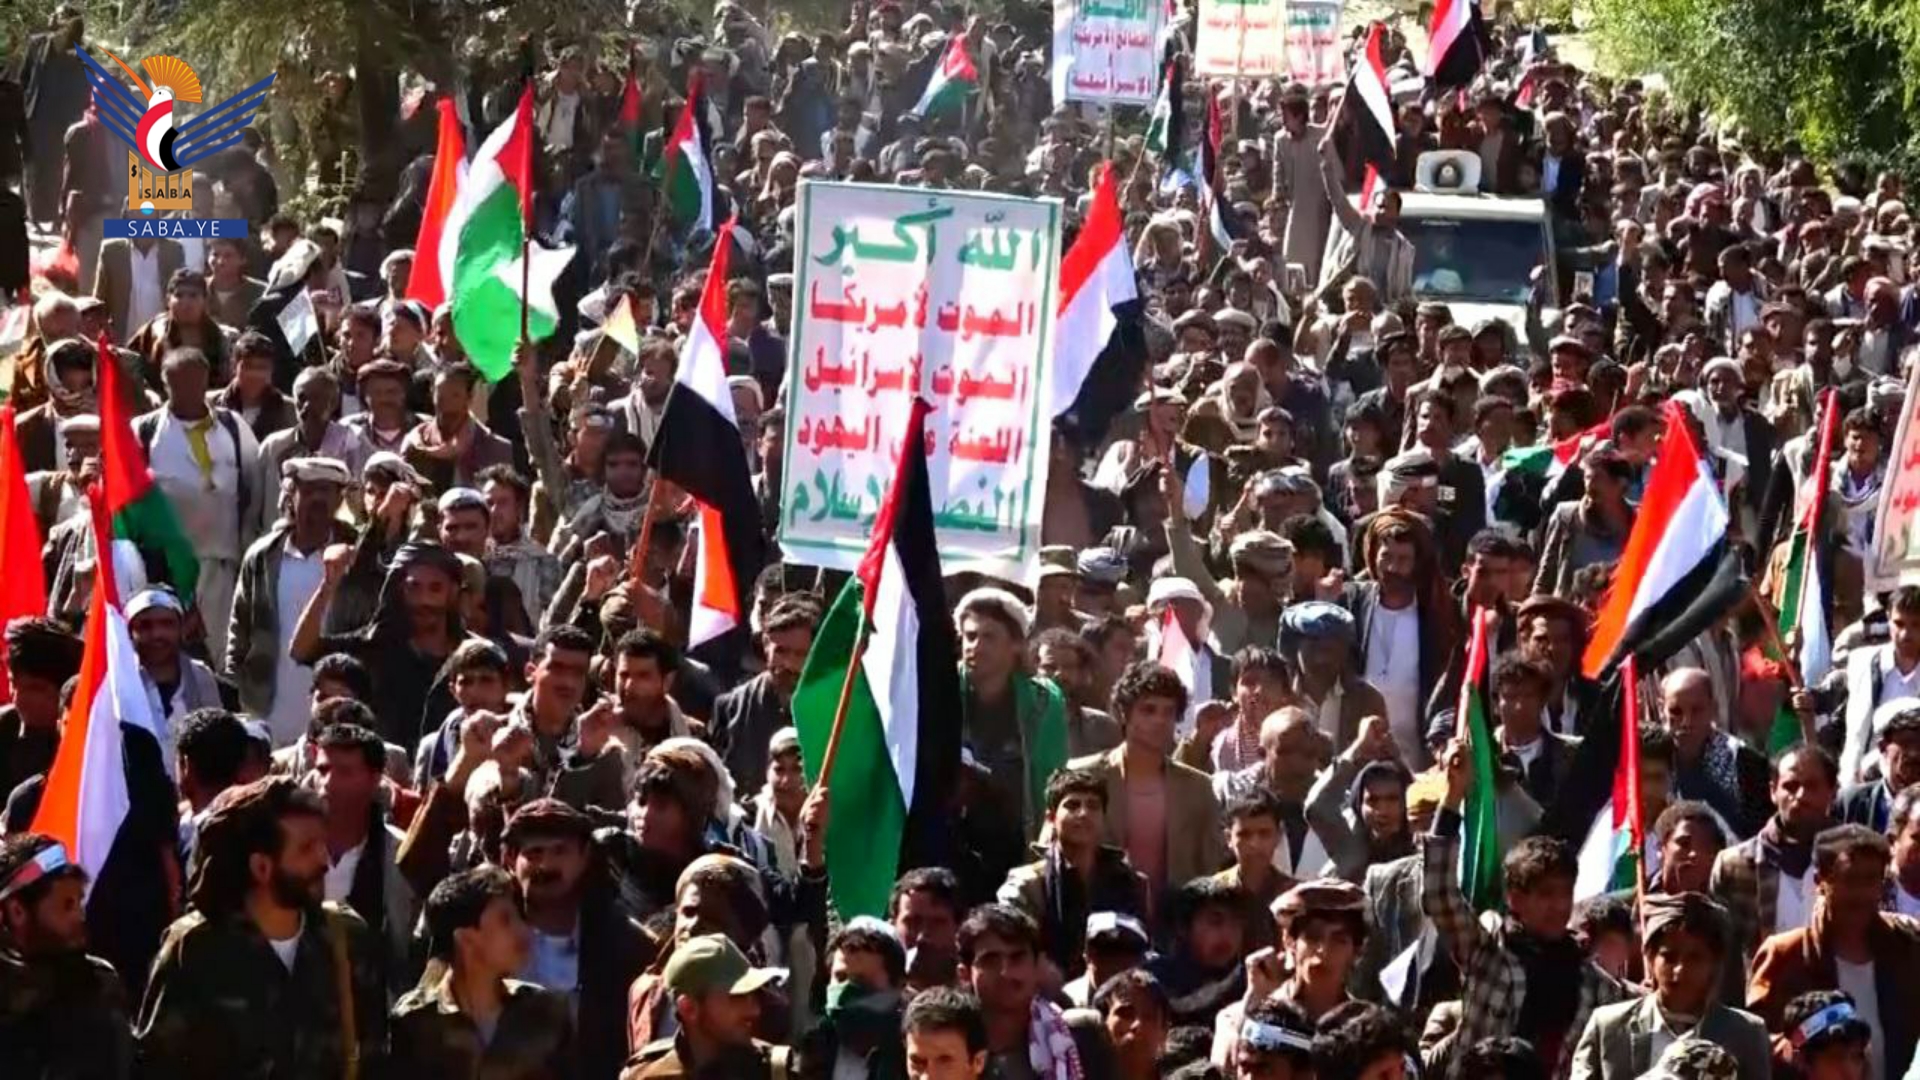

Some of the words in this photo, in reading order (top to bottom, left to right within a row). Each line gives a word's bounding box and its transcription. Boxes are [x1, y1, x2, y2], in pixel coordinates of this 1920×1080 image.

[813, 198, 954, 276] أكبر
[957, 211, 1041, 272] الله
[810, 280, 929, 334] لأمريكا
[936, 301, 1034, 342] الموت
[931, 363, 1028, 406] الموت
[797, 414, 881, 460] اليهود
[890, 428, 936, 464] عى
[948, 420, 1023, 463] اللعنة
[934, 474, 1016, 532] النص
